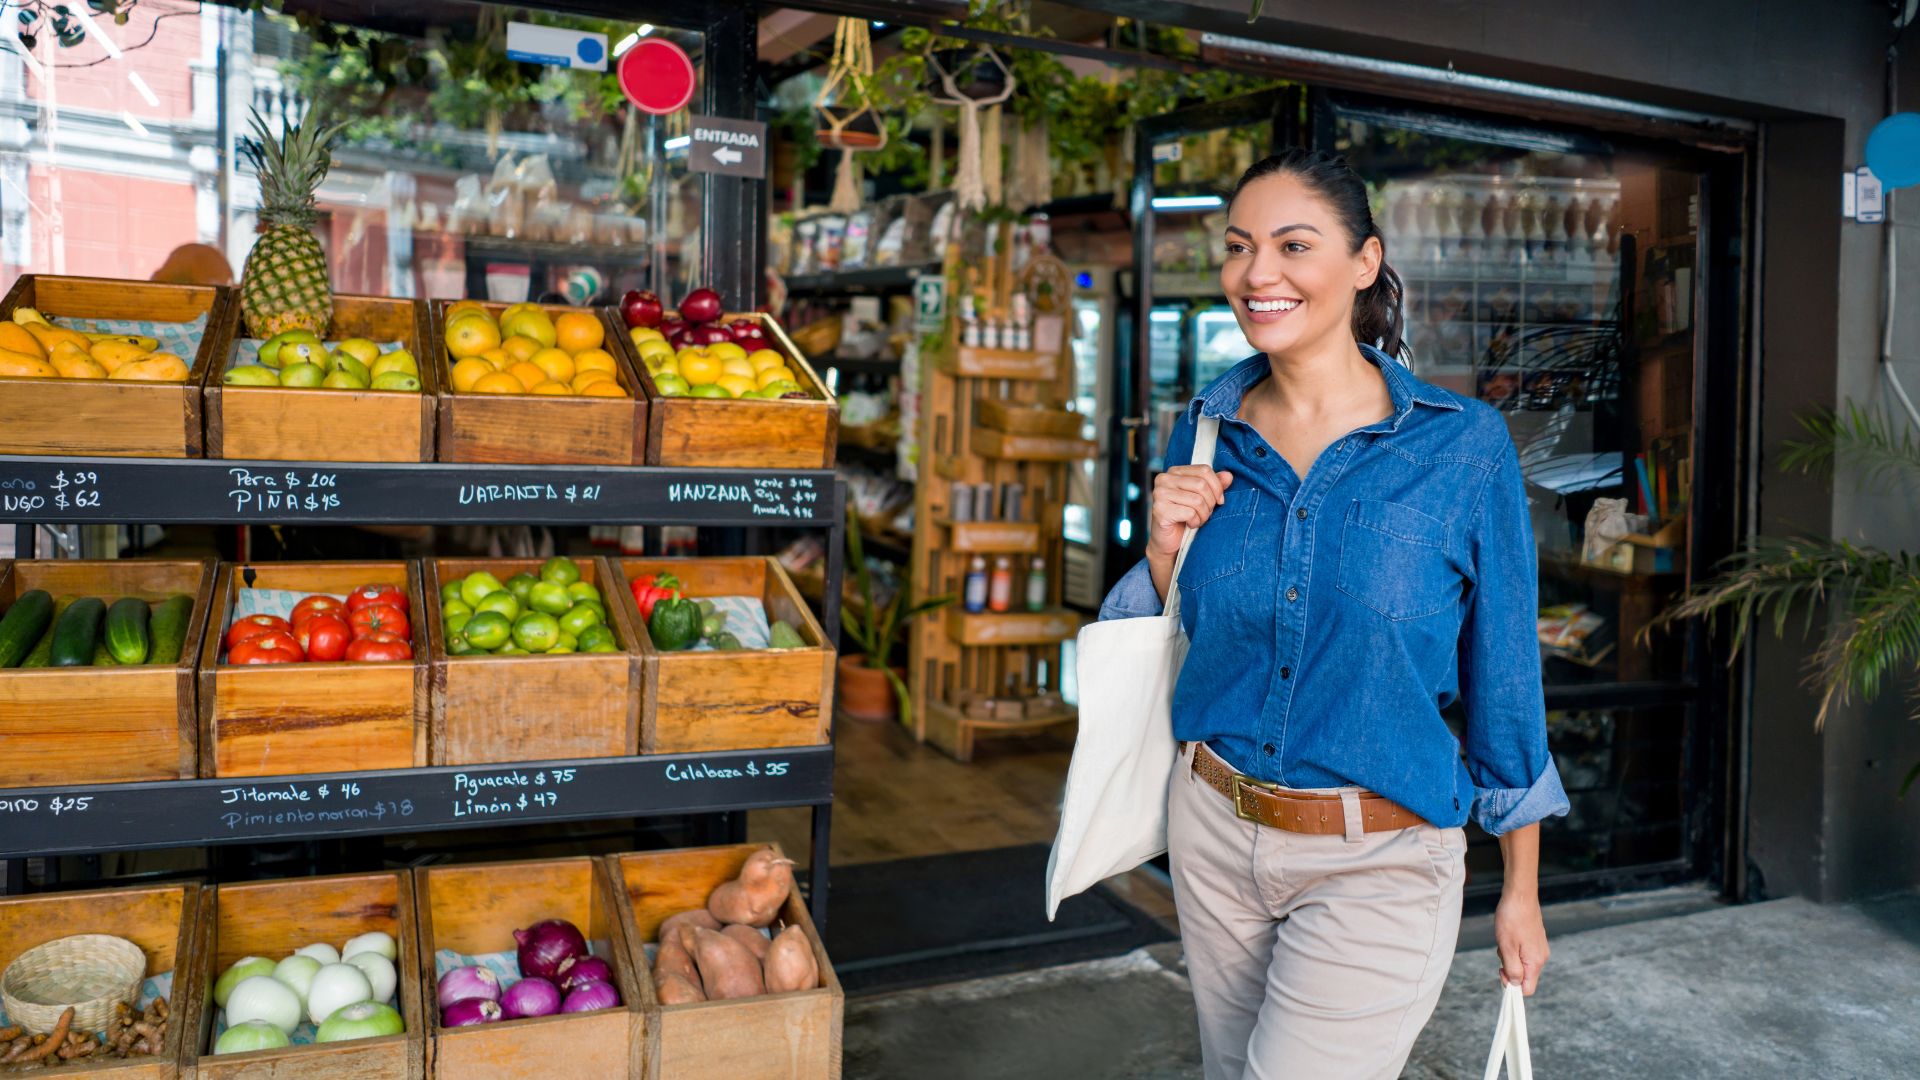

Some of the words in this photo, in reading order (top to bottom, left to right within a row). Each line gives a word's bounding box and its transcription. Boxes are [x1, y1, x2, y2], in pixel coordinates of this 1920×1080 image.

[693, 127, 760, 148] ENTRADA
[73, 471, 98, 485] 39
[228, 467, 277, 487] Pera
[307, 472, 337, 488] 106
[4, 494, 45, 513] NGO
[75, 489, 101, 508] 62
[228, 489, 299, 513] PIÑA
[321, 493, 341, 511] 45
[582, 484, 601, 501] 21
[668, 483, 752, 503] MANZANA
[454, 770, 529, 797] Aguacate
[551, 768, 577, 784] 75
[665, 762, 743, 782] Calabaza
[764, 762, 790, 776] 35
[220, 784, 311, 804] Jitomate
[341, 782, 361, 800] 46
[454, 796, 512, 817] Limón
[533, 791, 558, 808] 47
